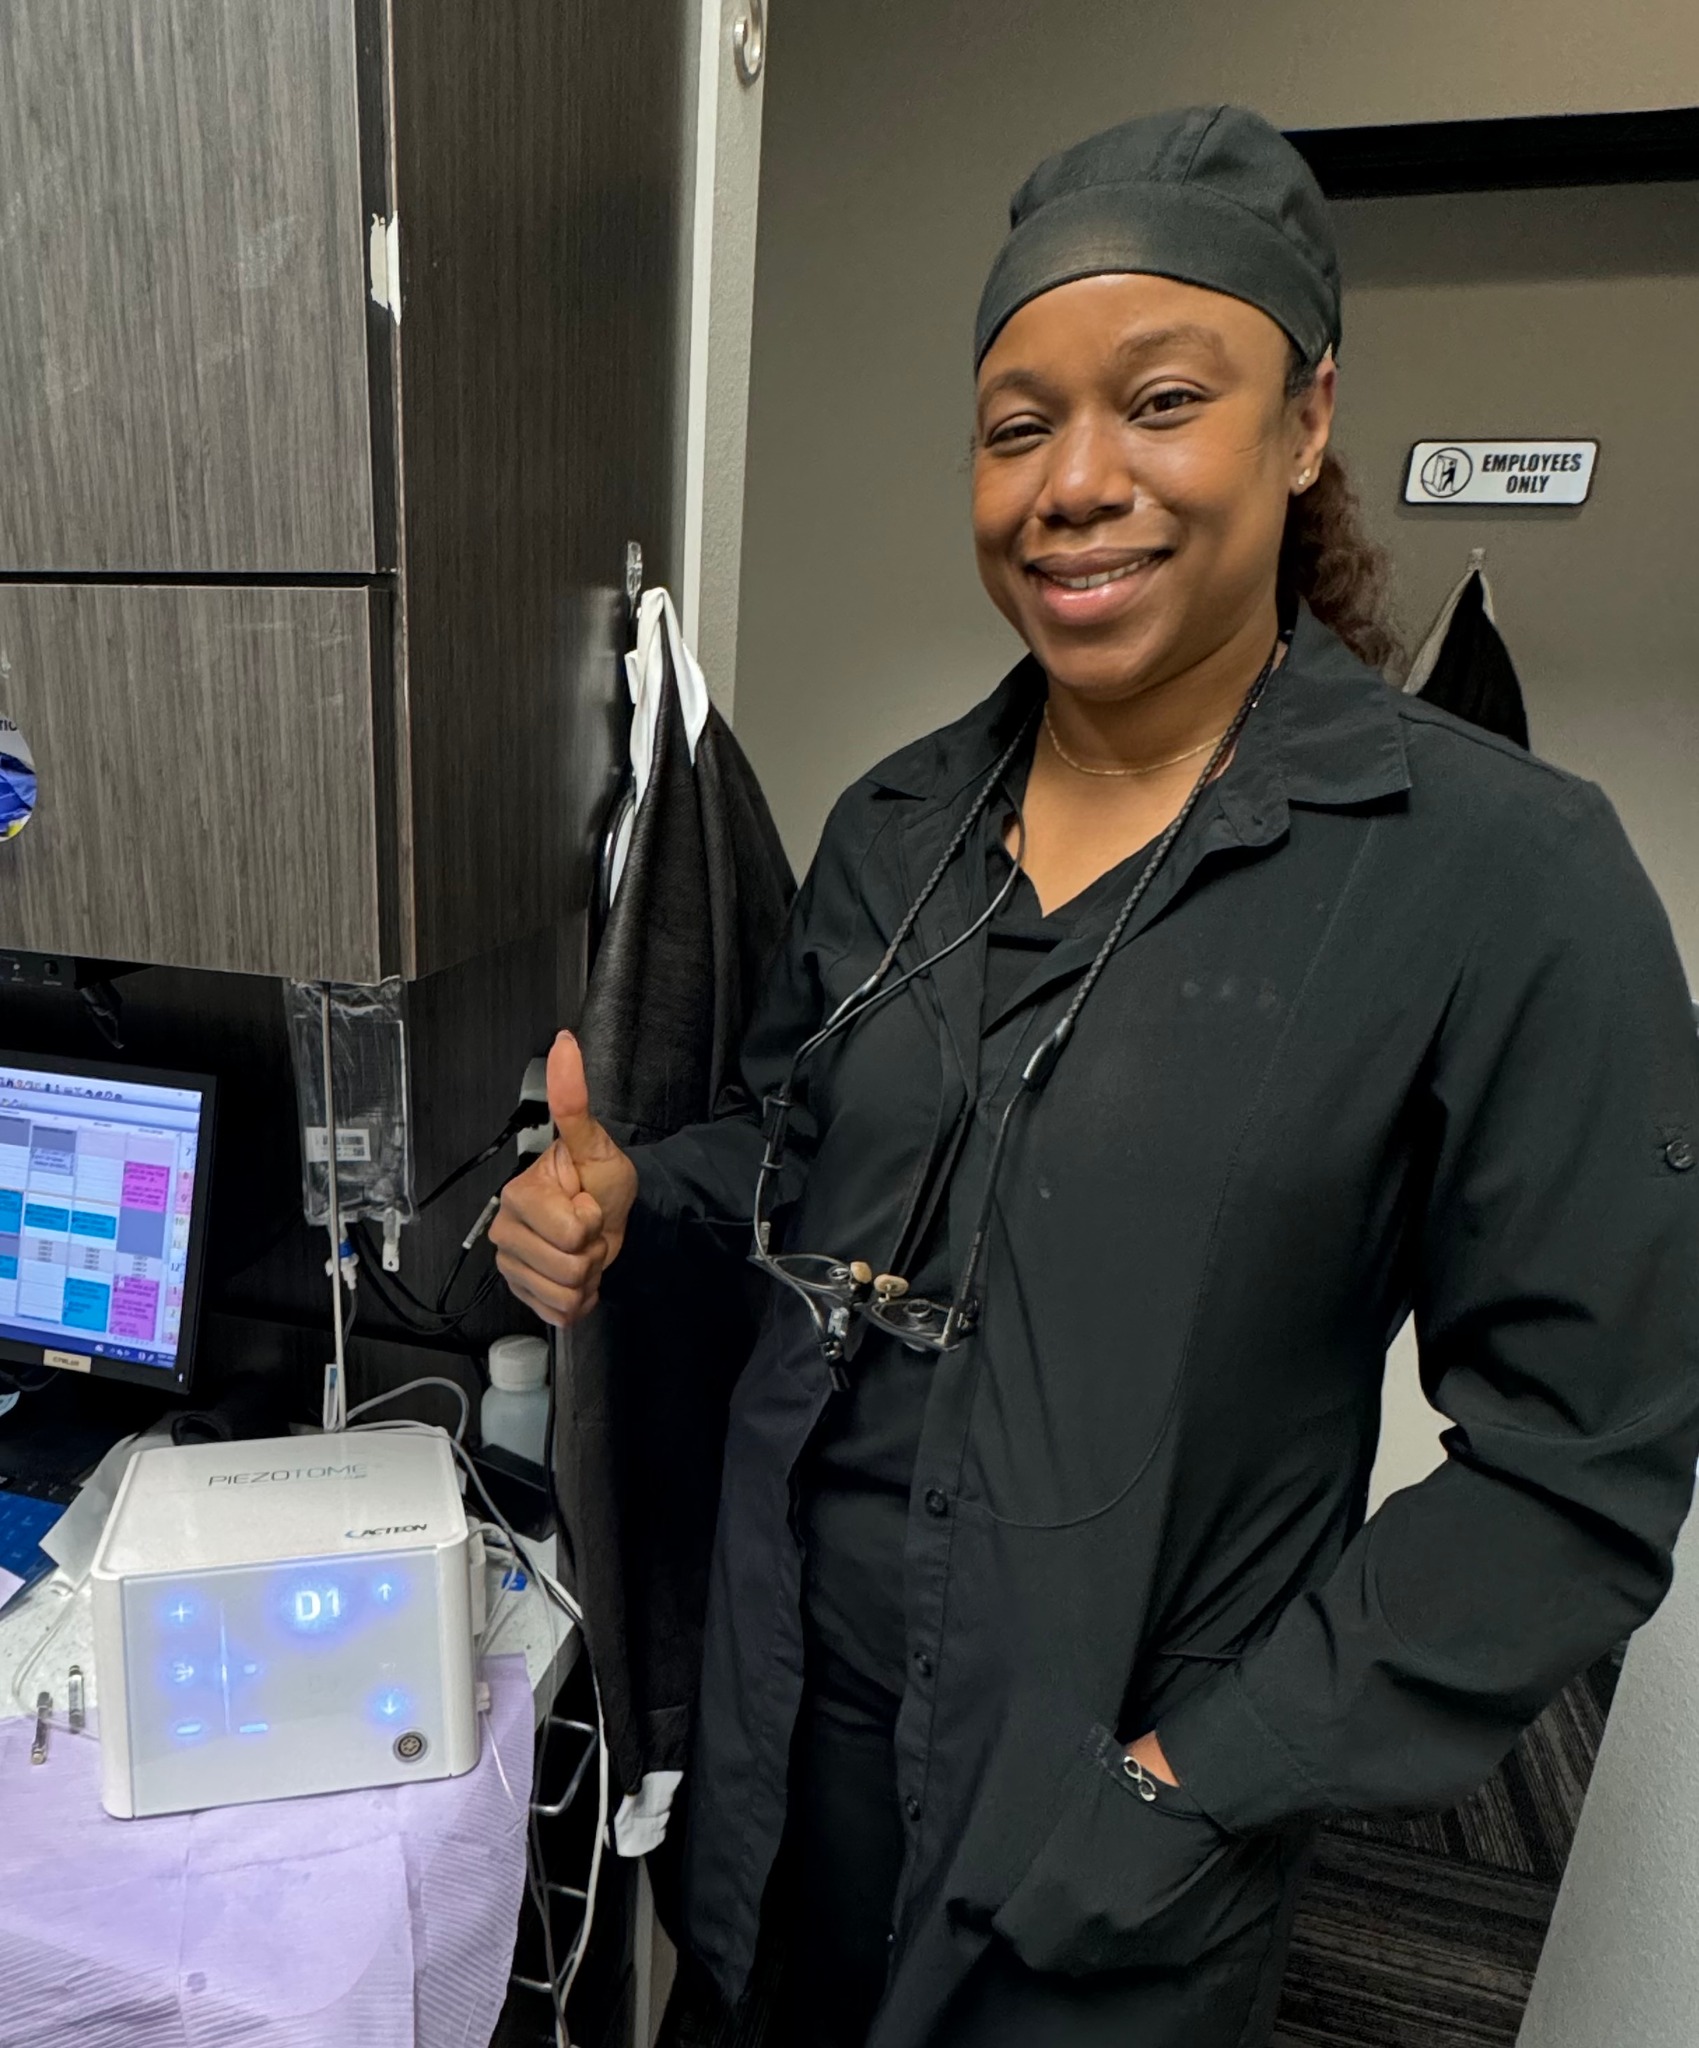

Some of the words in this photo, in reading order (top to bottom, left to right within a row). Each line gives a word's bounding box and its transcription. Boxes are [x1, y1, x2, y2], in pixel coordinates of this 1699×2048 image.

[1482, 453, 1582, 472] EMPLOYEES
[1506, 475, 1551, 494] ONLY
[208, 1463, 368, 1487] PIEZOTOME
[295, 1587, 341, 1622] D1
